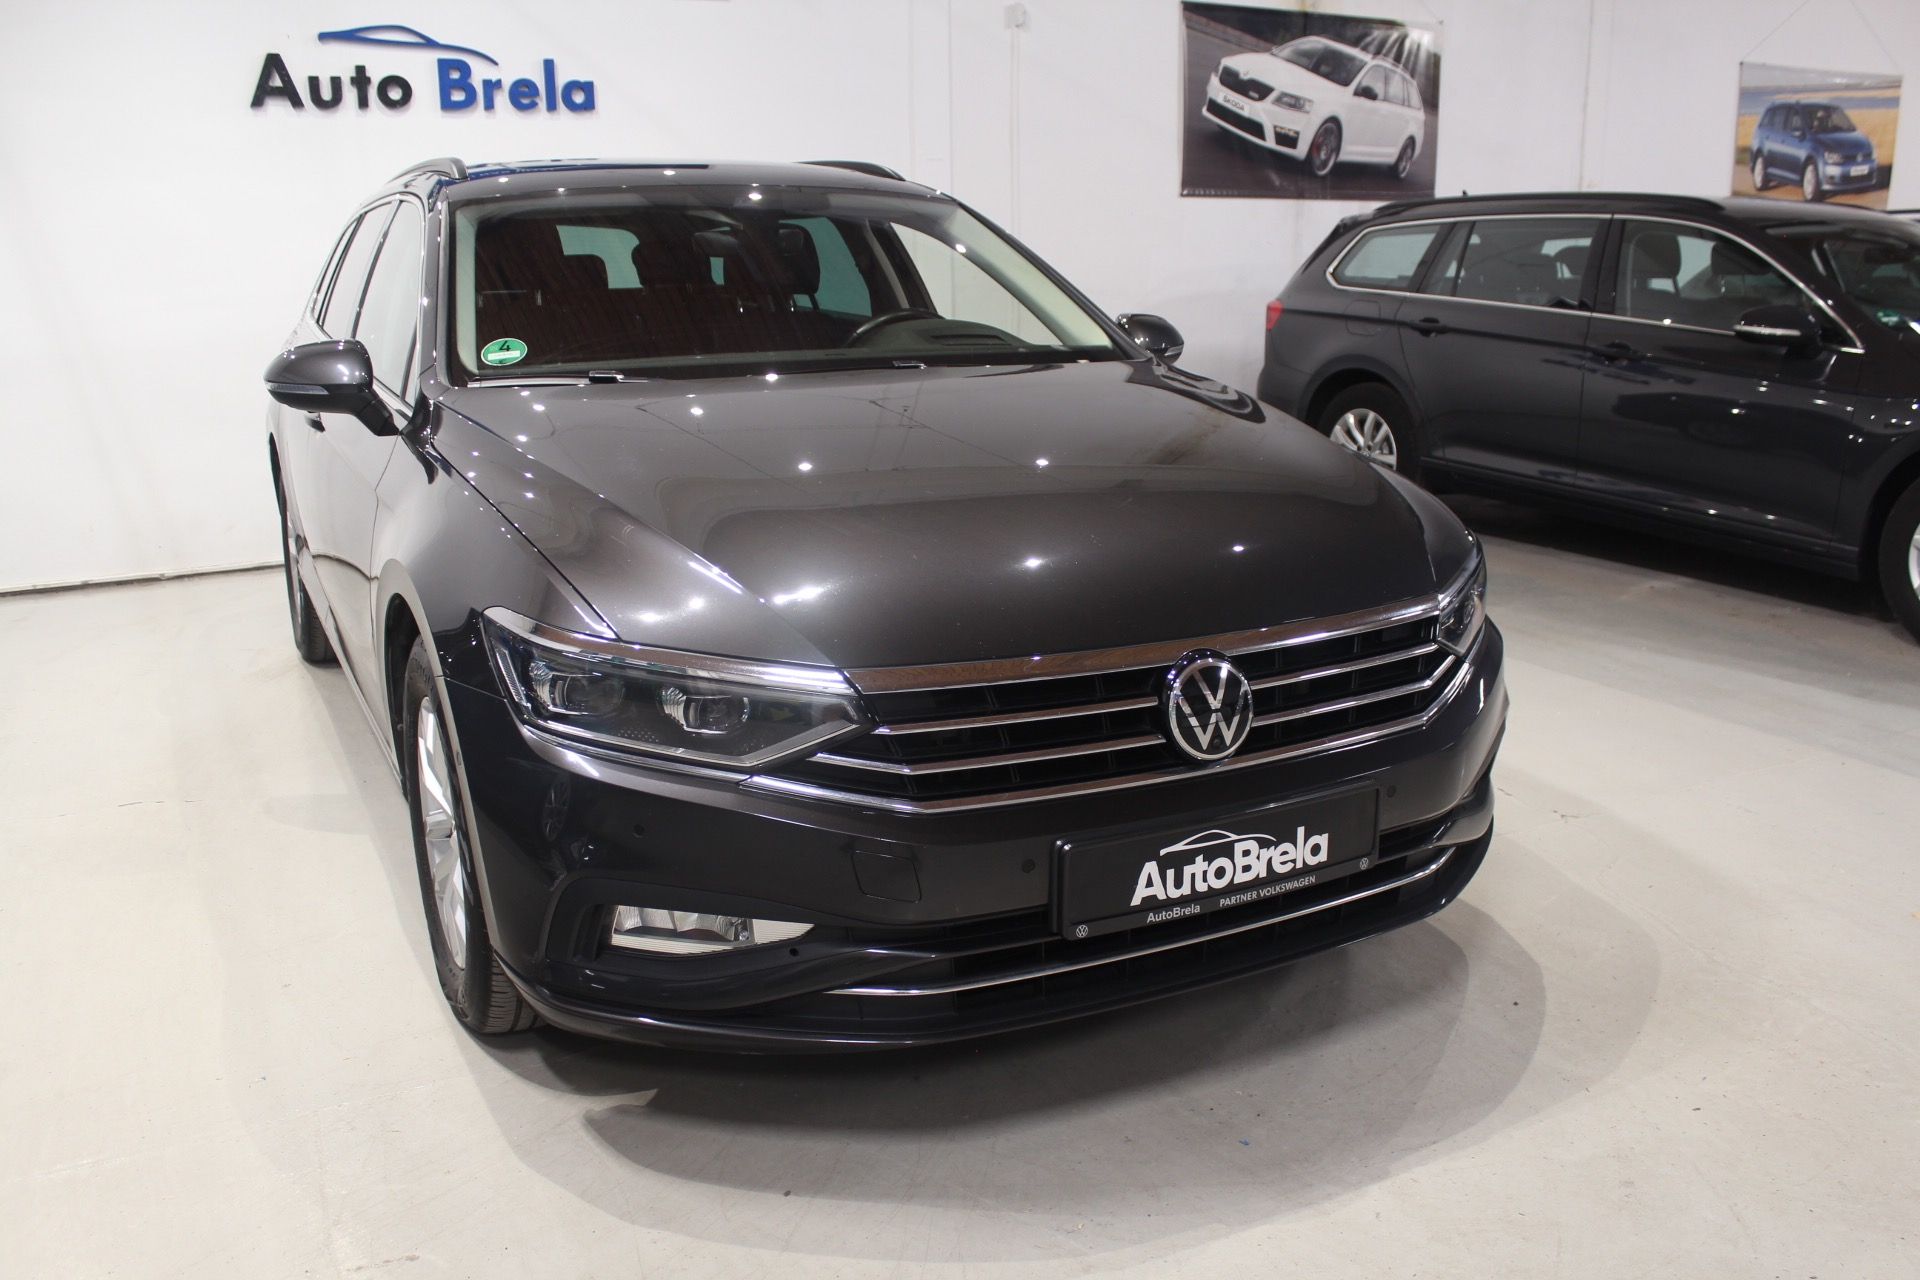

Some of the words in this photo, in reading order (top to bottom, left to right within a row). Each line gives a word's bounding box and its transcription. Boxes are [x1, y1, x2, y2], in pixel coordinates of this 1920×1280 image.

[251, 53, 413, 110] Auto
[437, 58, 596, 112] Brela
[499, 340, 511, 351] 4
[1130, 826, 1329, 906] AutoBrela
[1219, 892, 1258, 908] PARTNER
[1259, 875, 1316, 898] VOLKSWAGEN
[1146, 904, 1201, 924] AutoBrela
